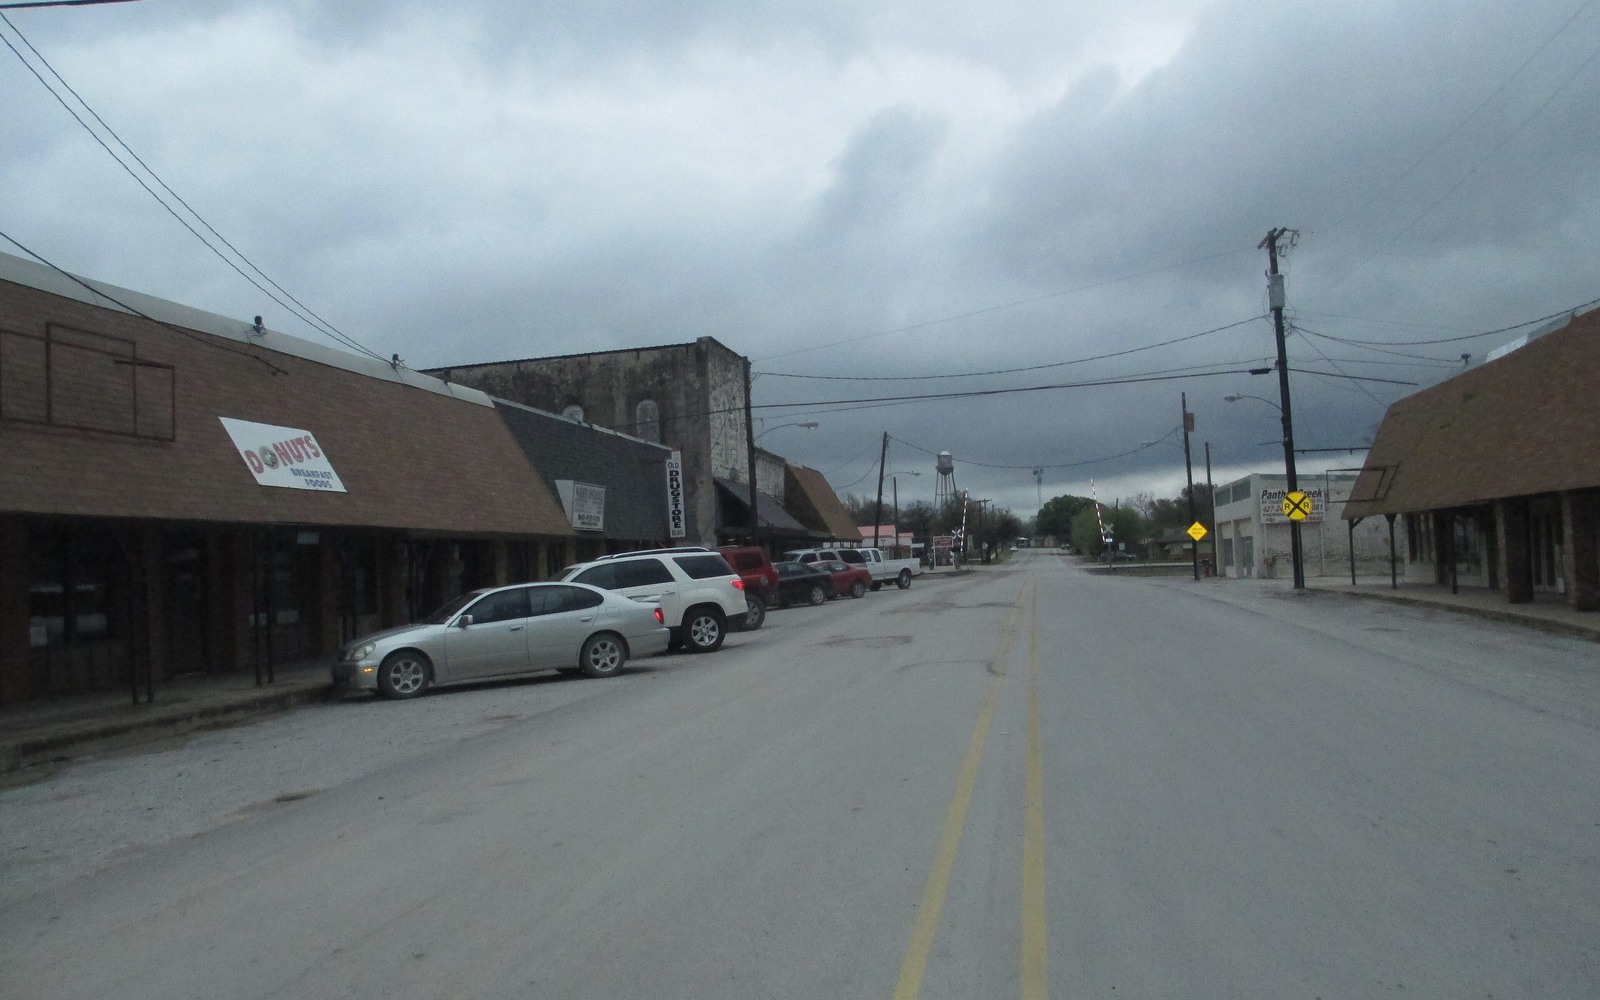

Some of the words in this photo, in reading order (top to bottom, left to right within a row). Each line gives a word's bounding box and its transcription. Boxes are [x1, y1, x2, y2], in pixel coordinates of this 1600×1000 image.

[244, 435, 320, 474] DONUTS
[290, 468, 333, 479] BREAKFAST
[306, 479, 333, 488] FOODS
[669, 470, 682, 529] DRUGSTORE
[1261, 489, 1286, 499] Panth
